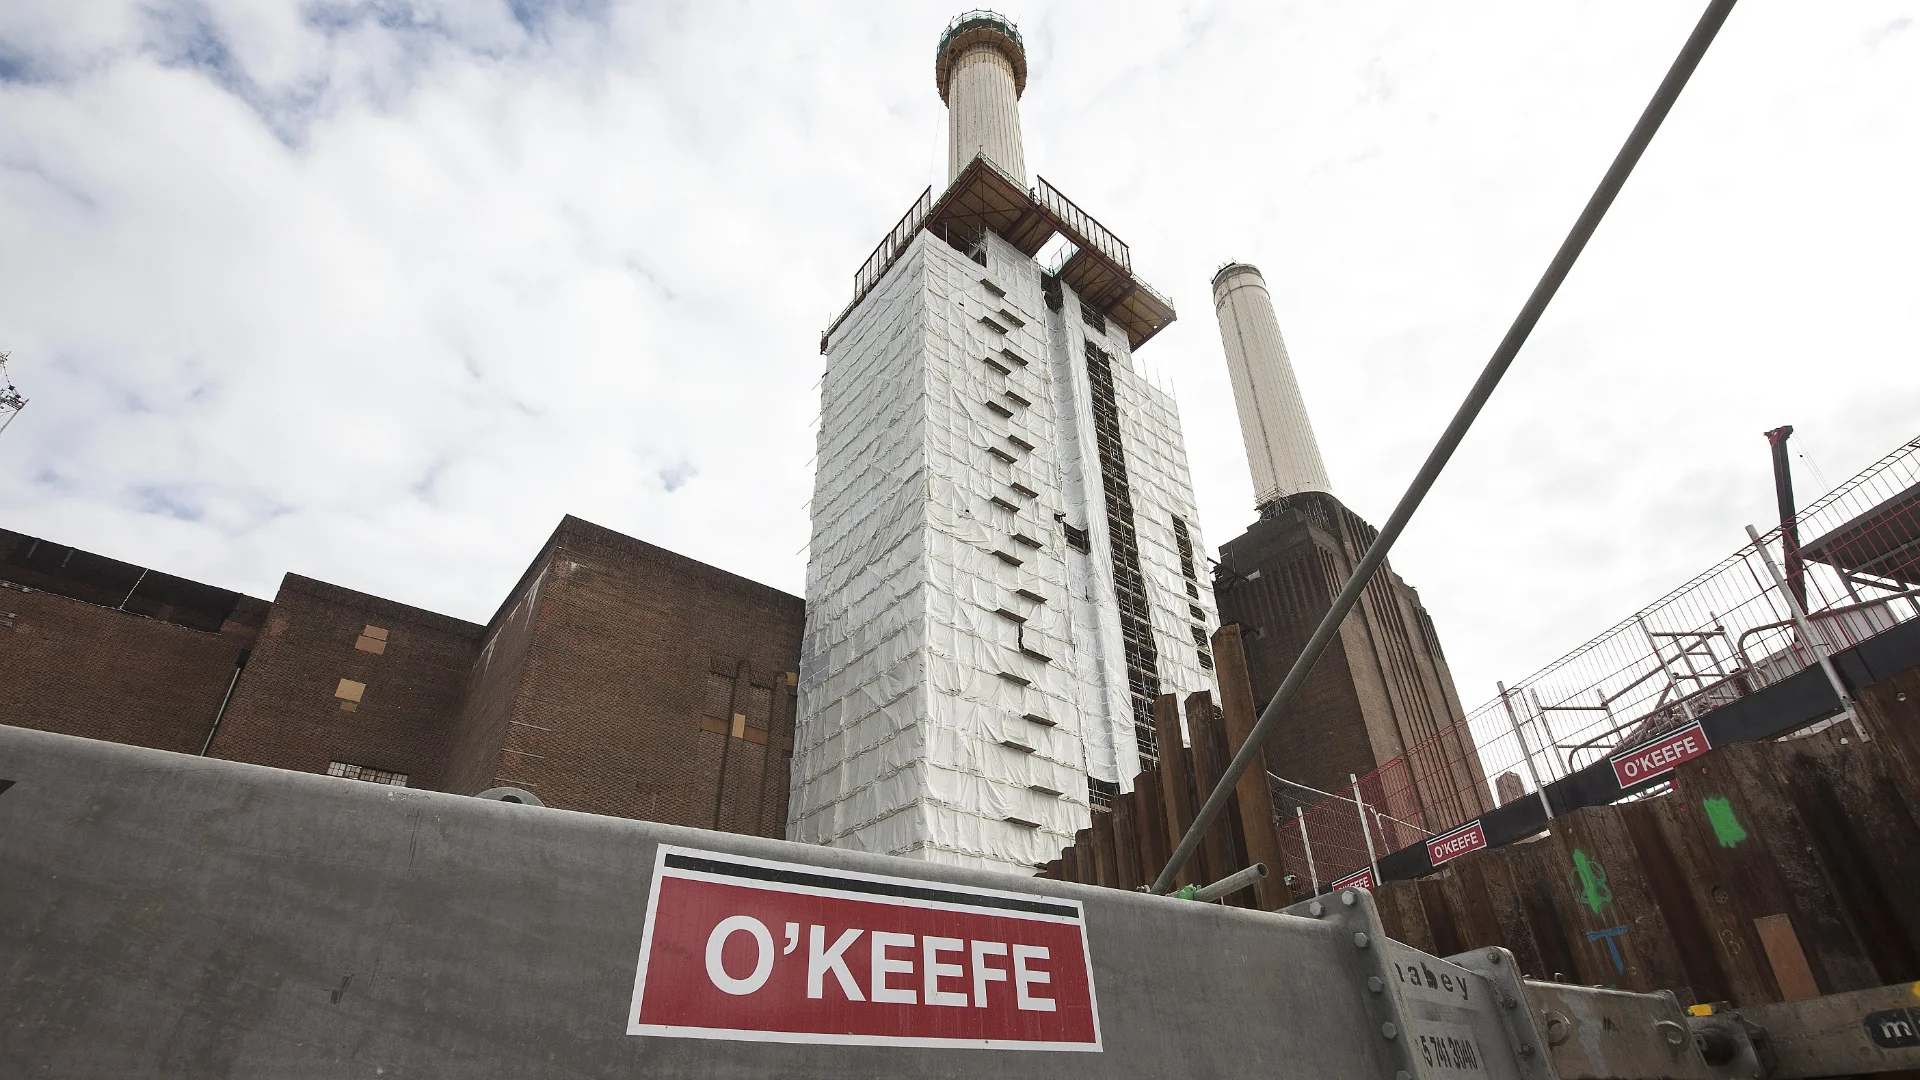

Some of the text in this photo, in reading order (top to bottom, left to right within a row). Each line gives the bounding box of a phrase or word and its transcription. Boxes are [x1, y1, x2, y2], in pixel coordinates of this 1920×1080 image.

[1623, 736, 1699, 778] O'KEEFE
[1434, 830, 1479, 859] O'KEEFE
[704, 915, 1058, 1012] O'KEEFE
[1880, 1020, 1920, 1038] m
